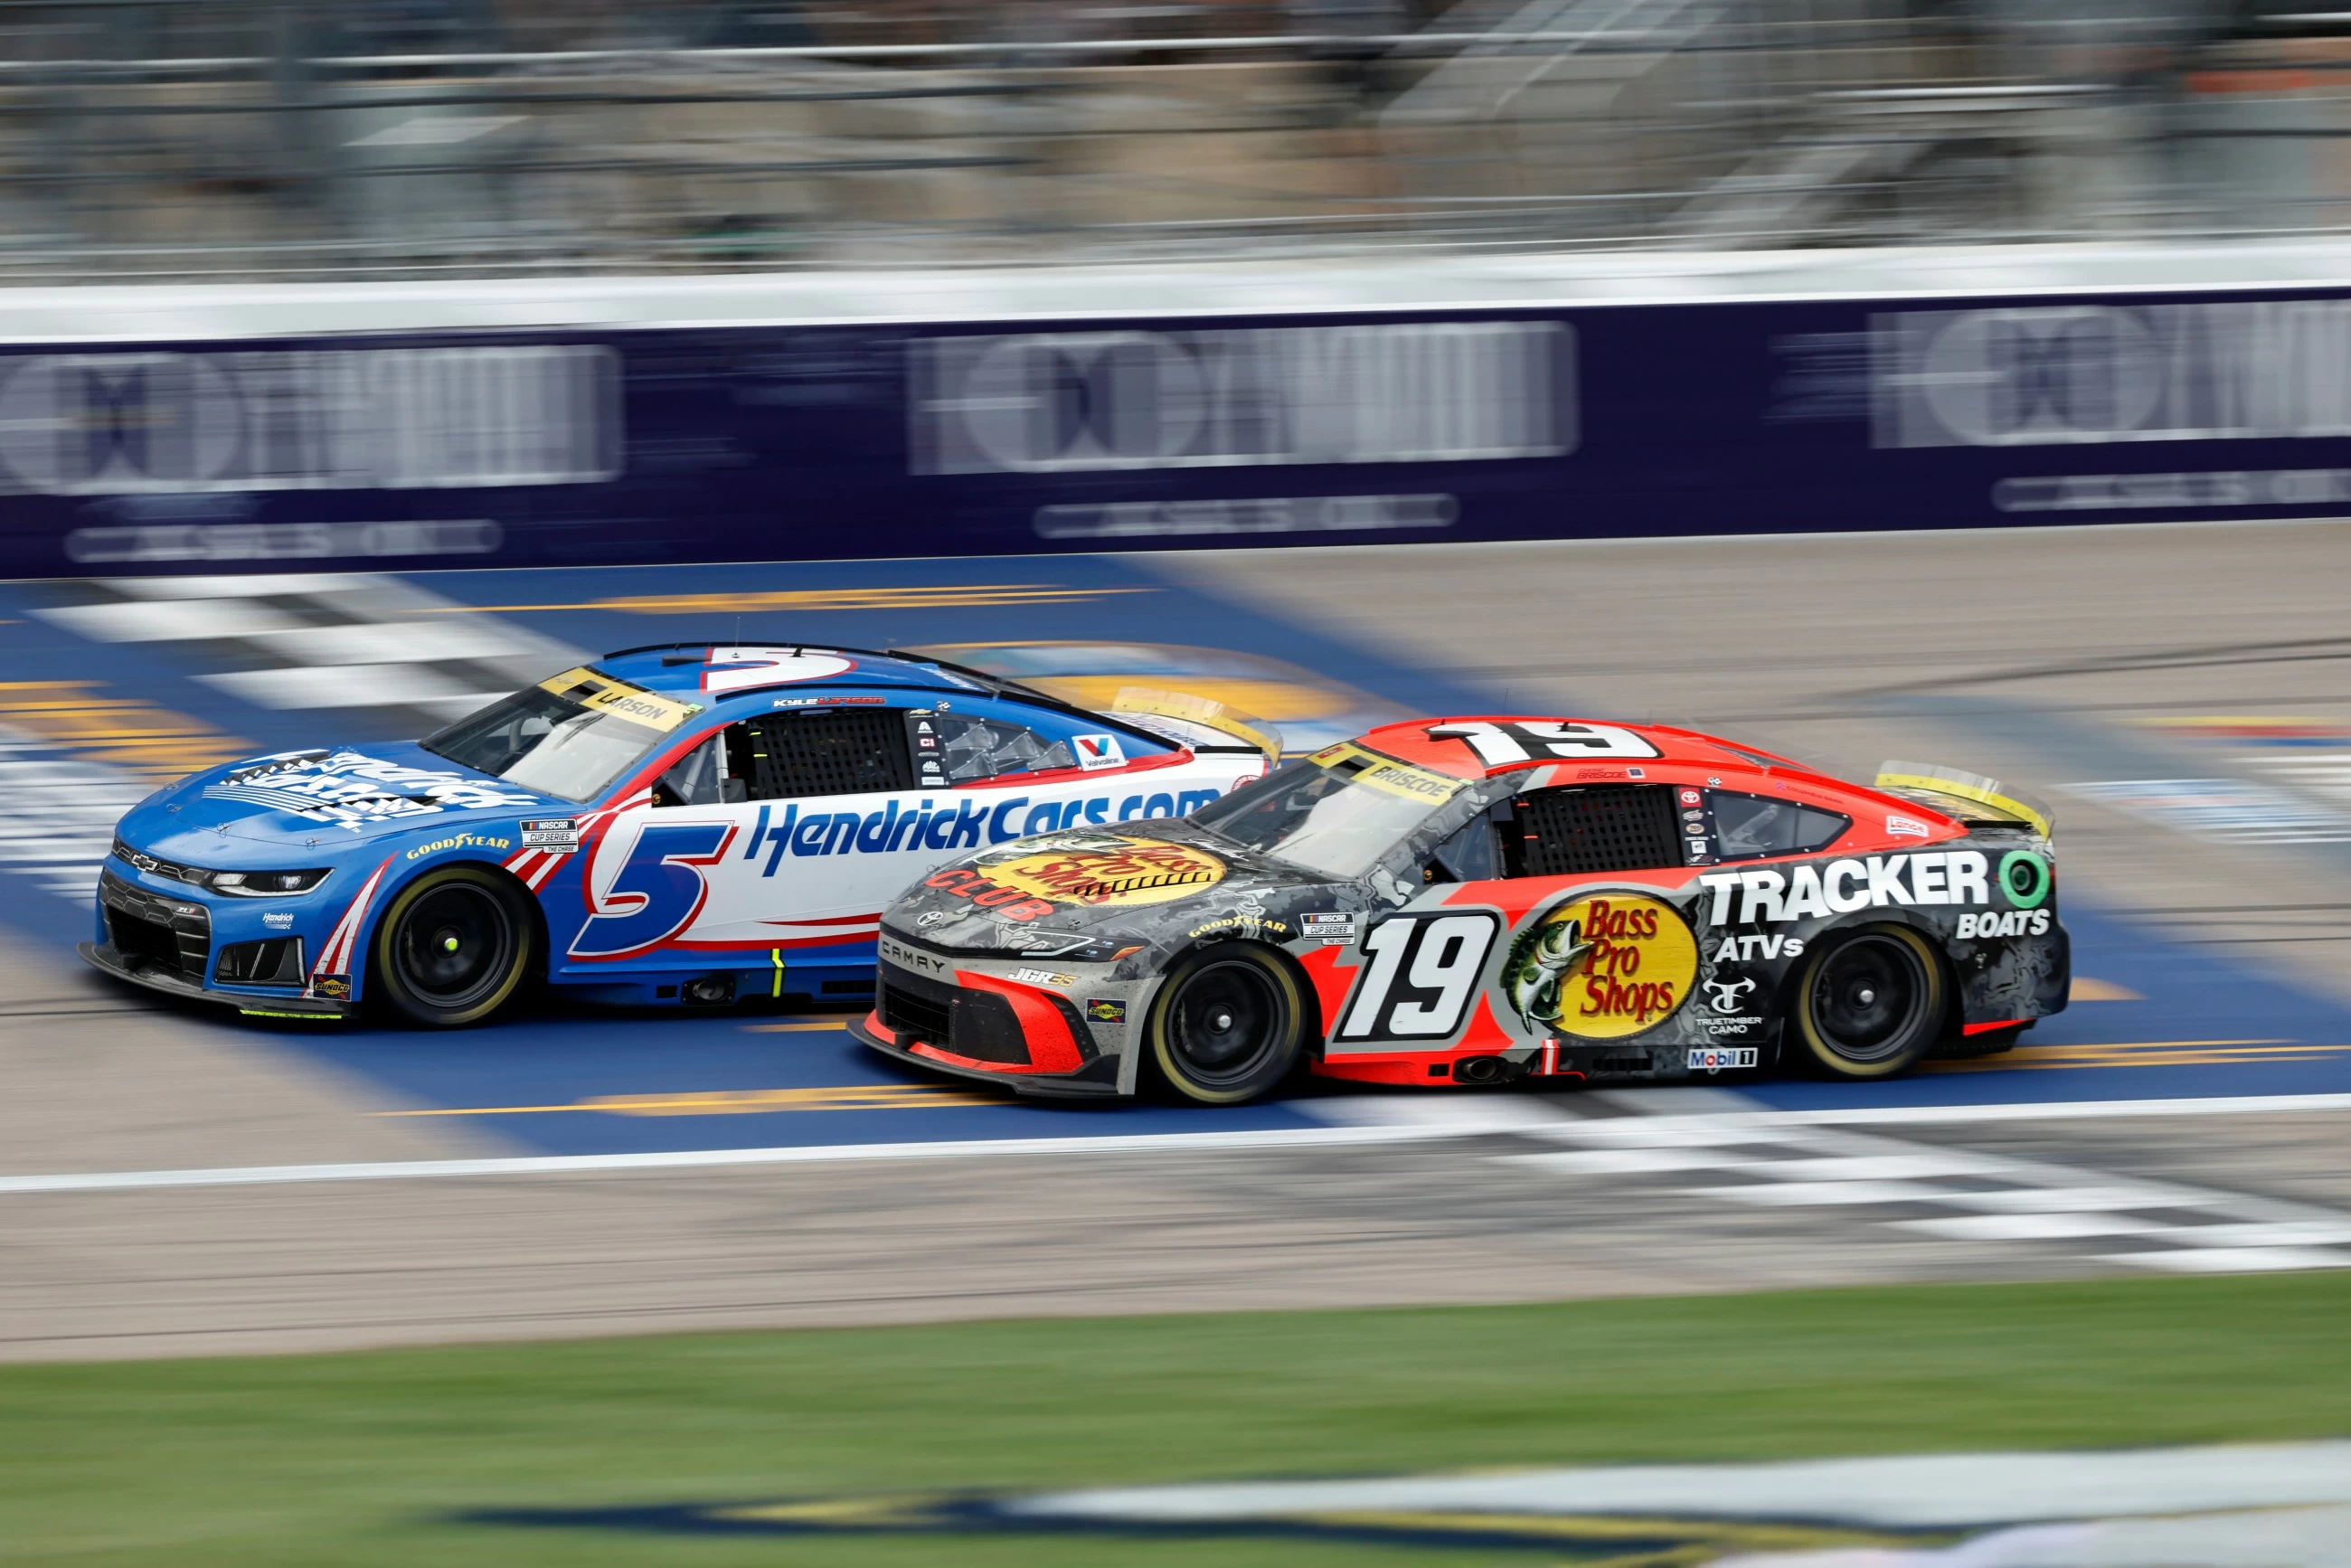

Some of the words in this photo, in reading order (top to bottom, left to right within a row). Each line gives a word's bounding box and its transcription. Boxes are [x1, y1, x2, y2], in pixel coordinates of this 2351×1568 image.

[597, 692, 667, 720] LARSON
[773, 698, 817, 707] KYLE
[1085, 757, 1119, 768] Valvoline
[1576, 771, 1628, 779] BRISCOE
[1374, 765, 1450, 798] BRISCOE
[530, 833, 544, 842] CUP
[544, 832, 571, 841] SERIES
[539, 820, 568, 830] NASCAR
[743, 788, 1221, 877] HendrickCarscom
[407, 832, 510, 860] GOODYEAR
[568, 823, 738, 959] 5
[925, 869, 1054, 922] CLUB
[1699, 850, 1989, 927] TRACKER
[262, 912, 295, 923] Hendrick
[1188, 914, 1288, 938] GOODYEAR
[1317, 914, 1346, 922] NASCAR
[1325, 925, 1348, 933] SERIES
[1581, 899, 1658, 939] Bass
[1956, 909, 2051, 940] BOATS
[883, 940, 946, 973] CAMRY
[1581, 939, 1640, 976] Pro
[1713, 934, 1804, 963] ATVs
[316, 982, 351, 993] SUNOCO
[1343, 914, 1497, 1038] 19
[1088, 1006, 1123, 1016] SUNOCO
[1581, 975, 1674, 1022] Shops
[1695, 1016, 1762, 1025] TRUETIMBER
[1709, 1025, 1748, 1034] CAMO
[1691, 1050, 1736, 1066] Mobil
